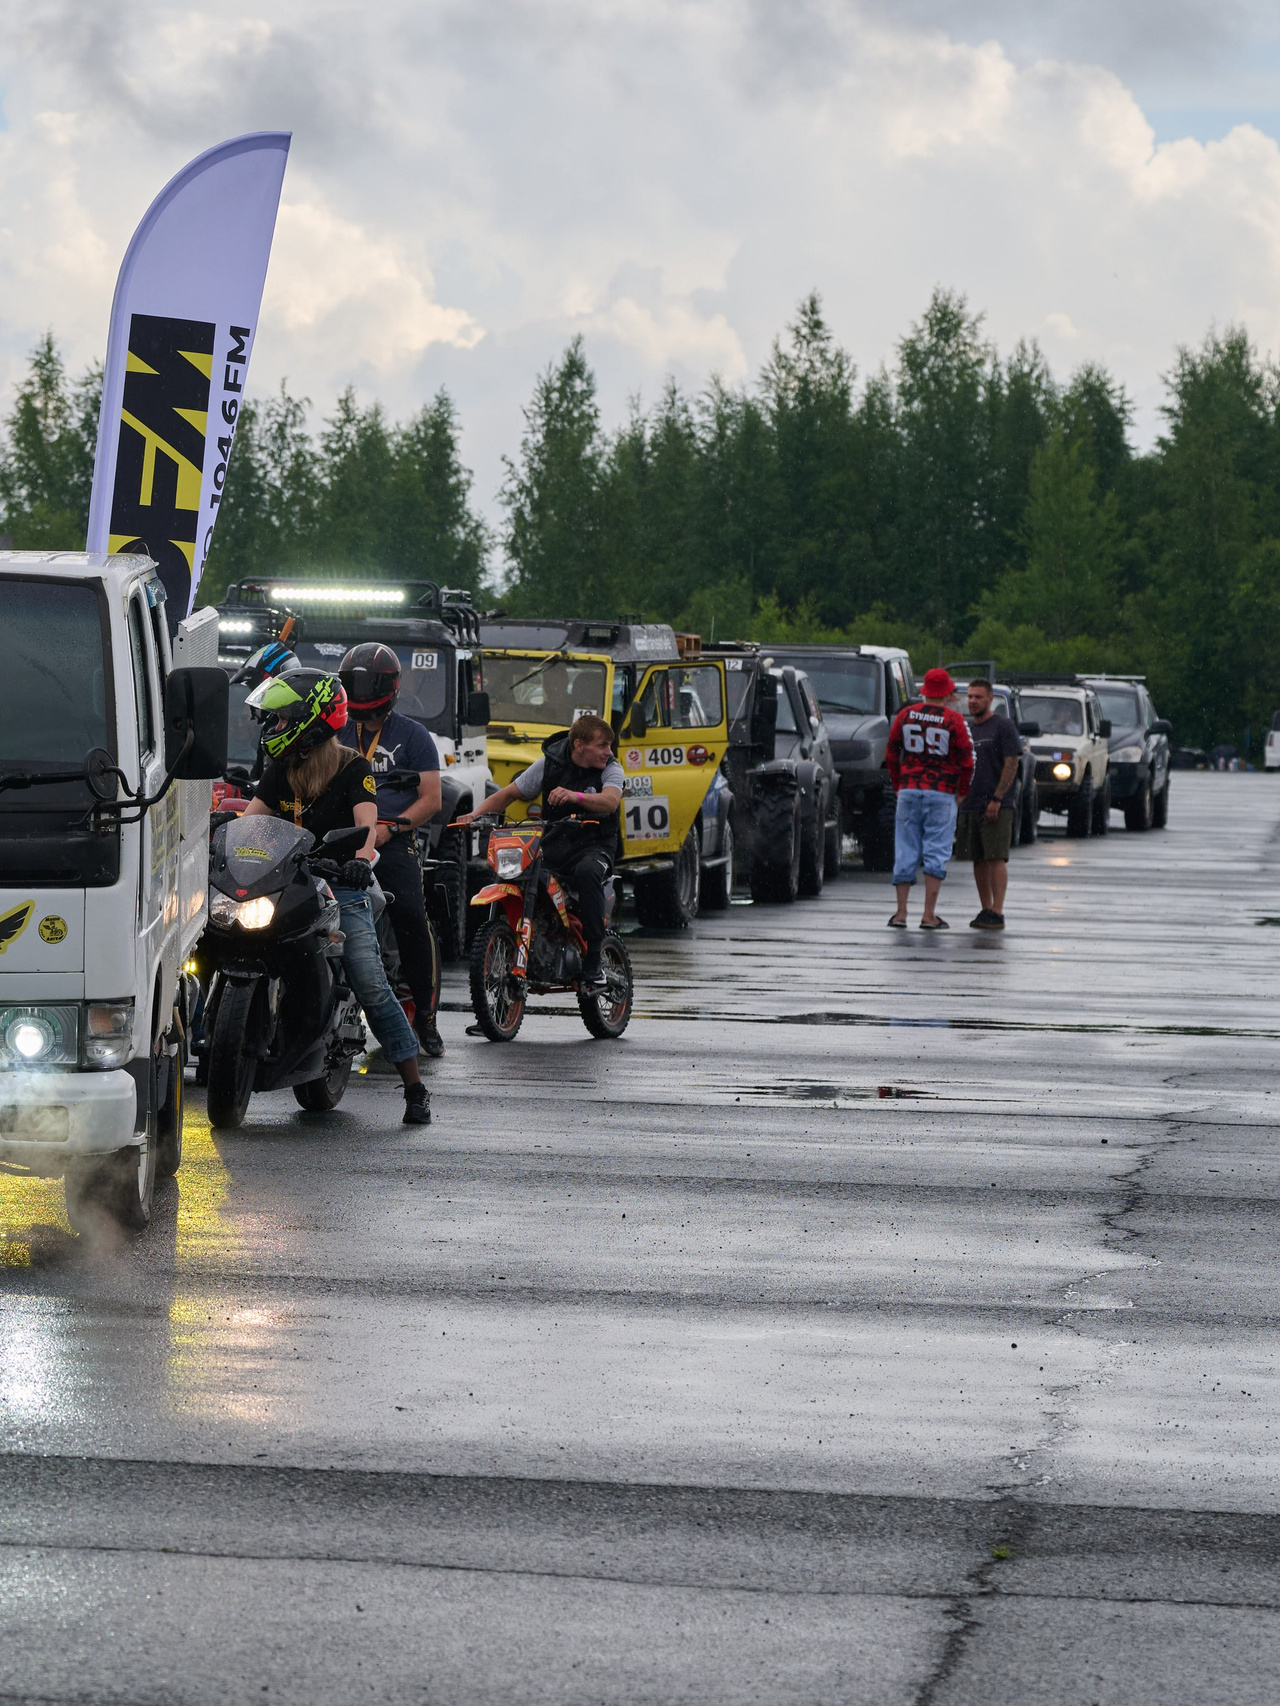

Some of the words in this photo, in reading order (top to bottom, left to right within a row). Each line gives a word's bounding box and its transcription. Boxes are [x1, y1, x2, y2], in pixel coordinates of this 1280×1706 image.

[415, 653, 435, 668] 09
[727, 660, 738, 669] 12
[902, 723, 950, 756] 69
[648, 747, 684, 765] 409
[626, 804, 669, 831] 10
